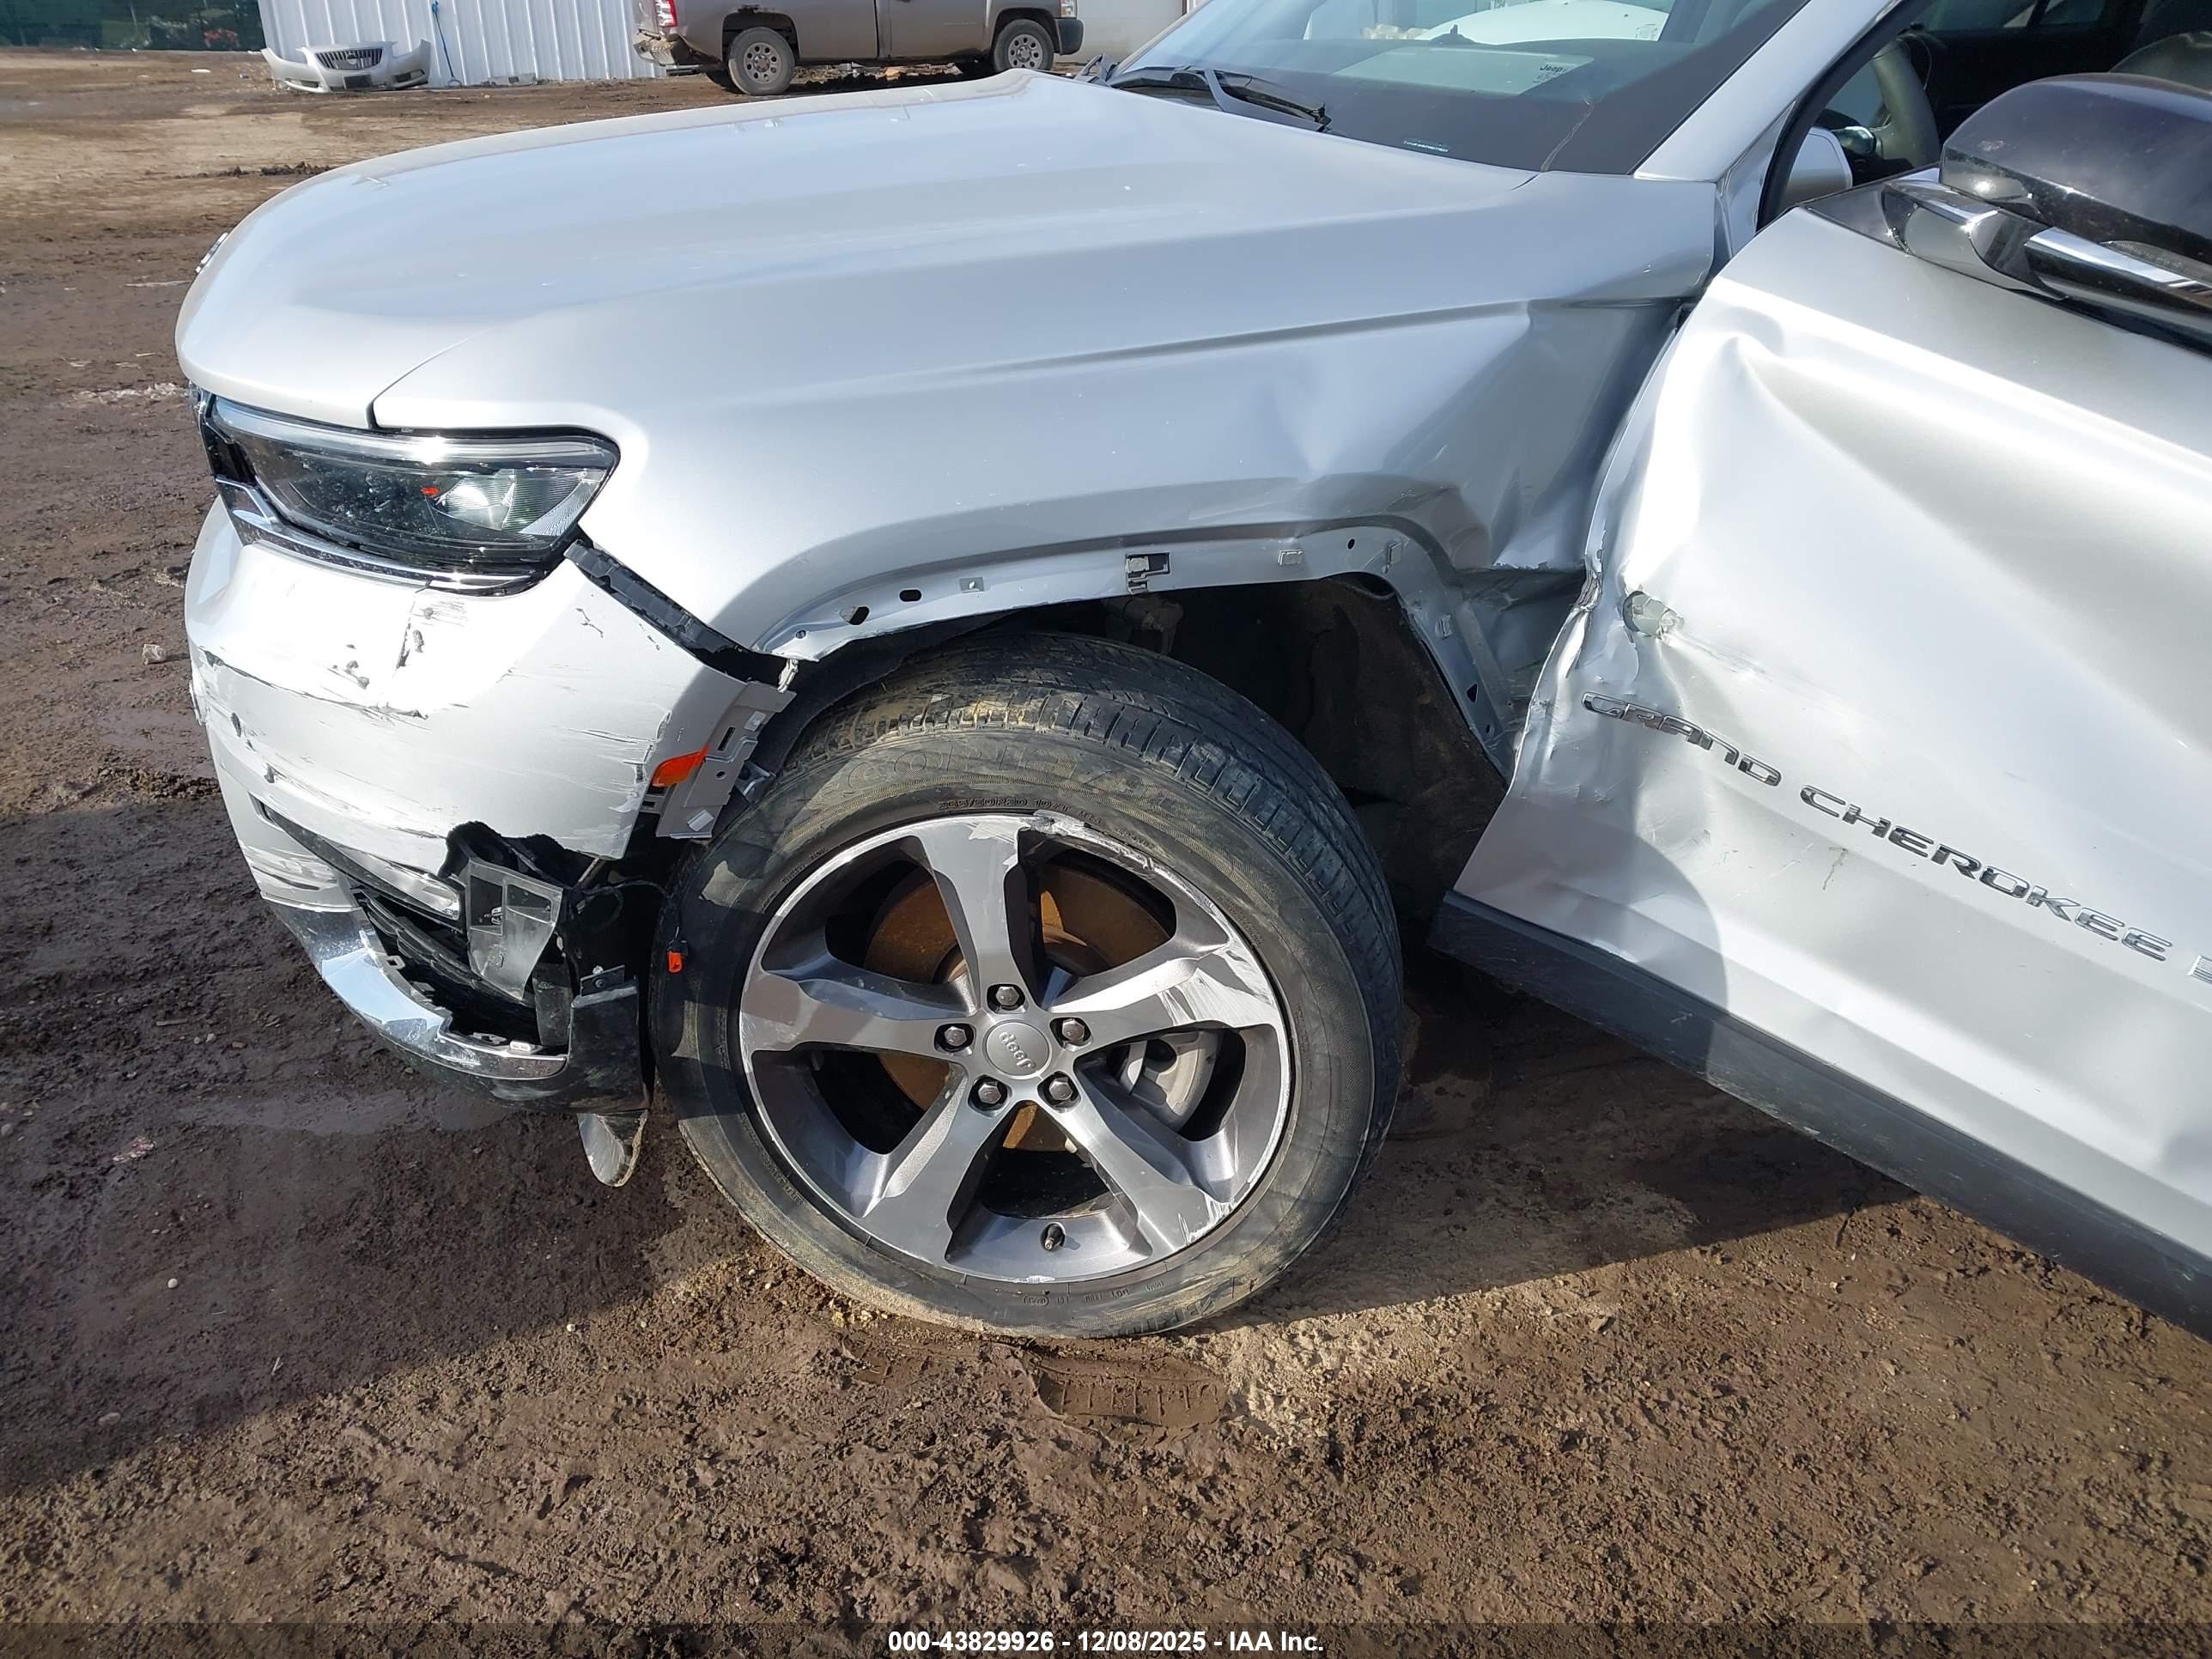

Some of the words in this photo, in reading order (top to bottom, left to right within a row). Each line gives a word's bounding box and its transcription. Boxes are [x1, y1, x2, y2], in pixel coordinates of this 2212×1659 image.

[1539, 64, 1564, 74] Jeep
[1581, 691, 1783, 787] GRAND
[1800, 784, 2173, 962] CHEROKEE
[999, 1031, 1036, 1070] Jeep
